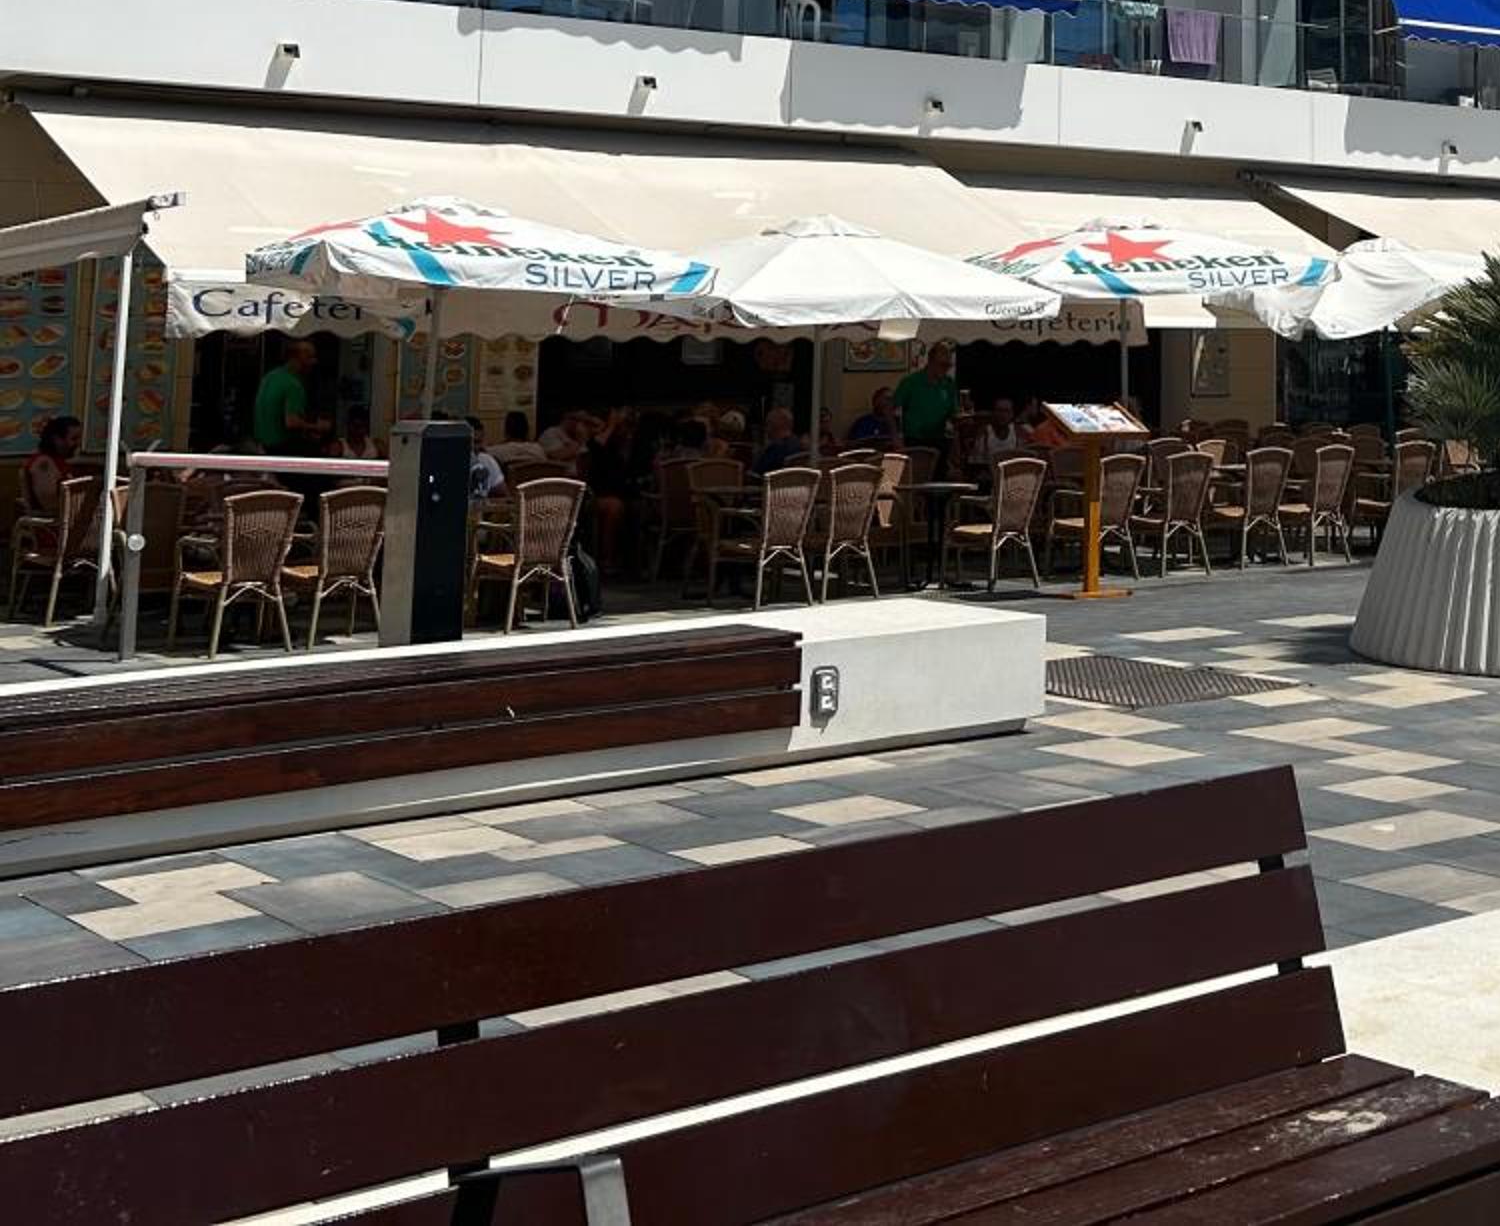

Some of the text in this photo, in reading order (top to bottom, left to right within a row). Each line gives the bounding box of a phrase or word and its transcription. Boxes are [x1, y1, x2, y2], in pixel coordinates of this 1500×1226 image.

[362, 229, 653, 266] Heineken
[525, 262, 657, 291] SILVER
[1062, 254, 1285, 274] Heineken
[1187, 267, 1289, 289] SILVER
[193, 288, 434, 324] Cafeter
